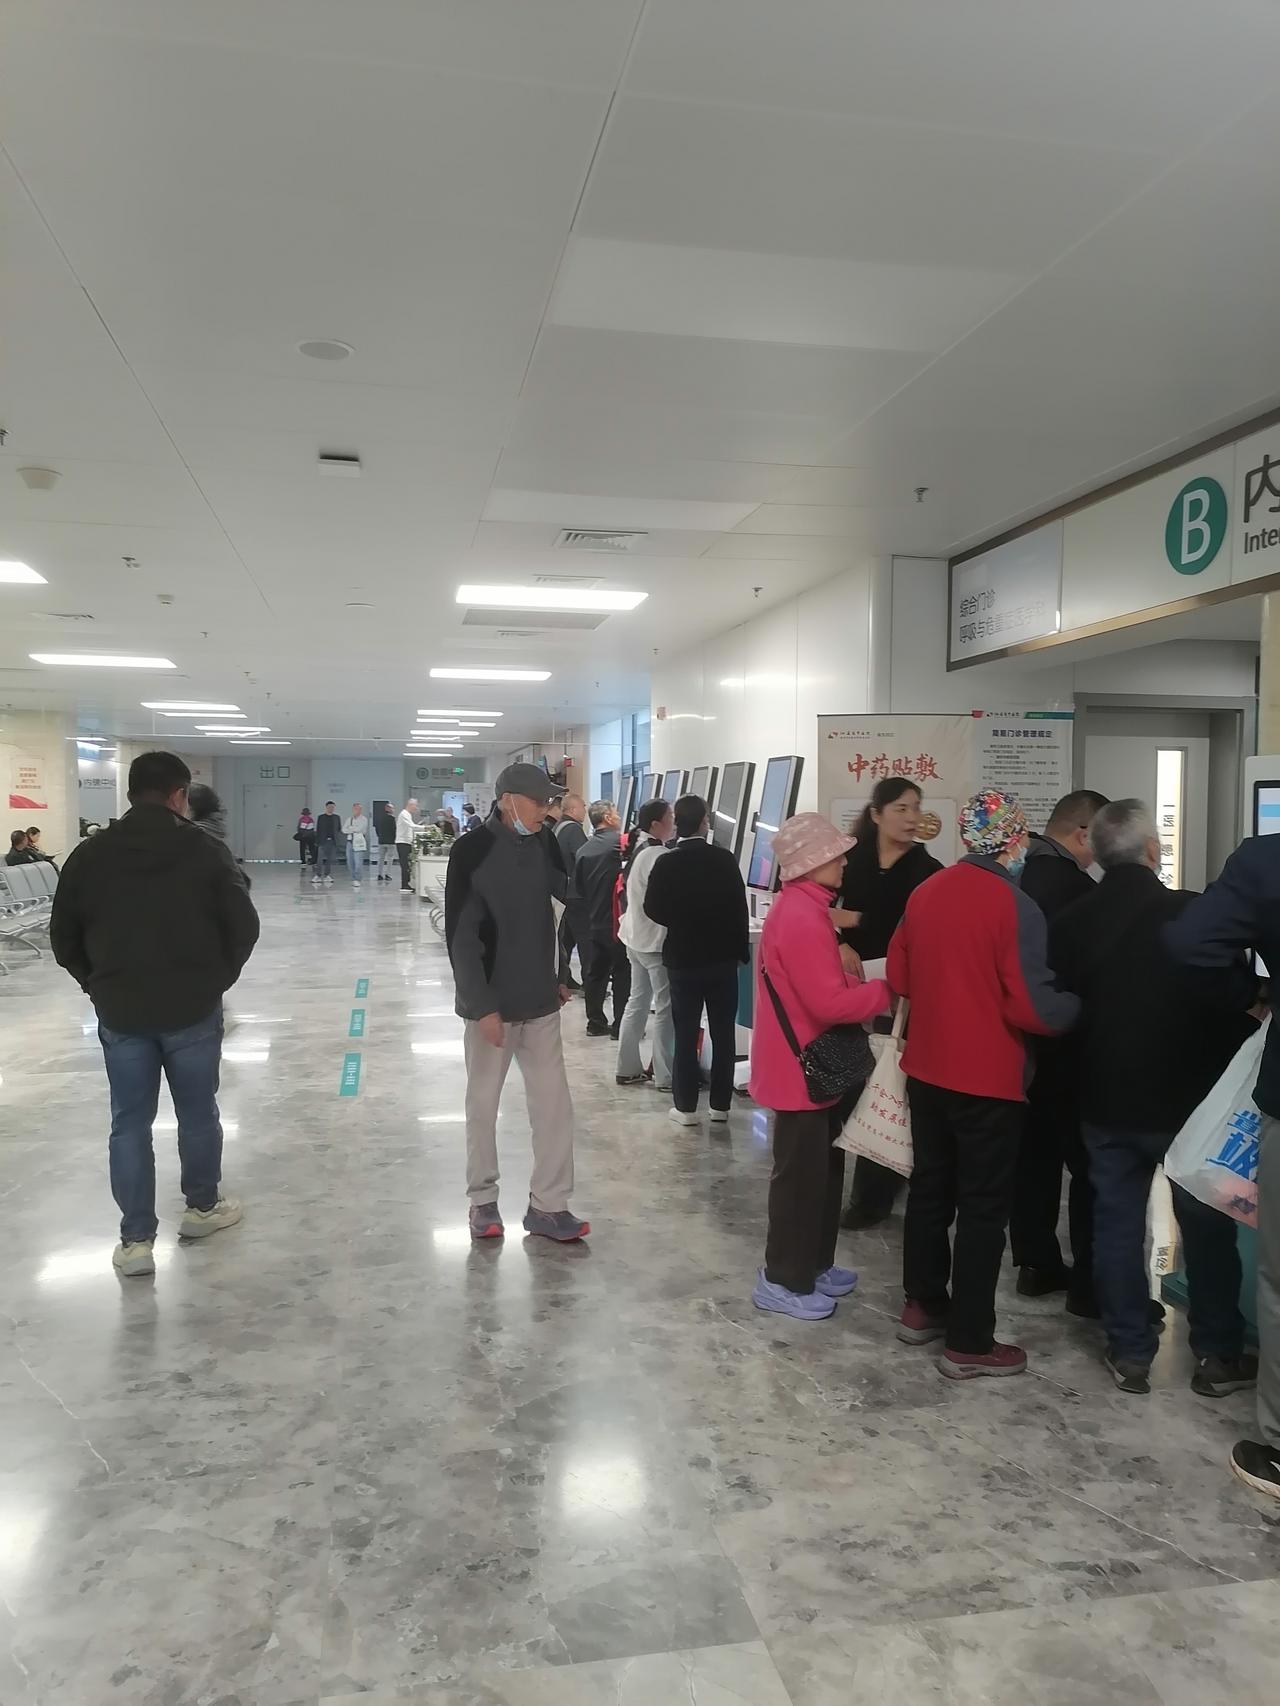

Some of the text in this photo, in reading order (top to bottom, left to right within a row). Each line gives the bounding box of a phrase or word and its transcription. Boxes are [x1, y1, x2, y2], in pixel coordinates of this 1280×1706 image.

[1180, 488, 1212, 565] B
[260, 765, 290, 779] 出口
[847, 752, 944, 783] 中药贴敷
